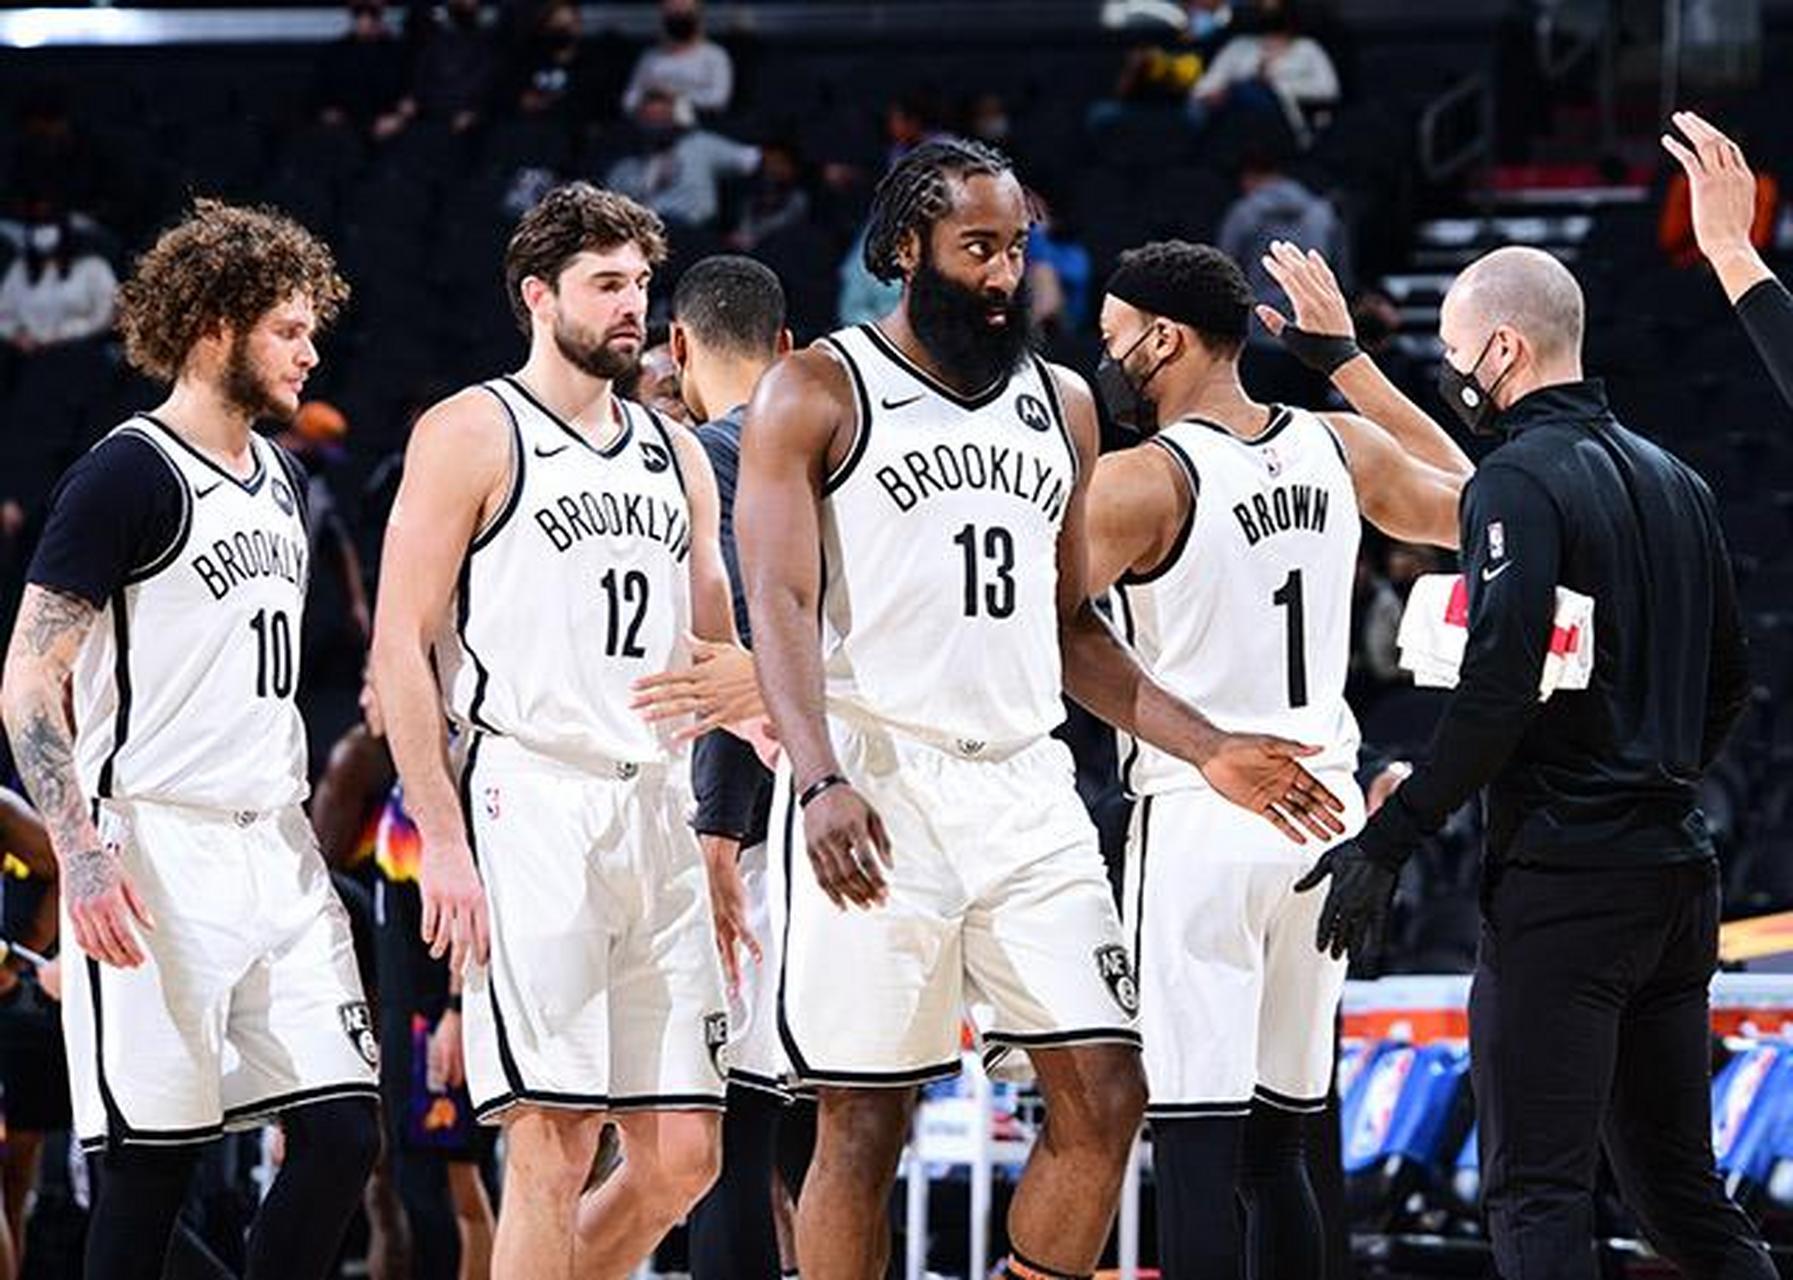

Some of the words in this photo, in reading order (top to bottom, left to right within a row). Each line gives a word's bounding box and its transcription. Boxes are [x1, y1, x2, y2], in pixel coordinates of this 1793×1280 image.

[875, 443, 1066, 522] BROOKLYN
[1232, 484, 1329, 547] BROWN
[192, 529, 305, 600] BROOKLY
[953, 523, 1016, 619] 13
[250, 608, 293, 700] 10
[601, 568, 650, 659] 12
[1273, 567, 1308, 709] 1
